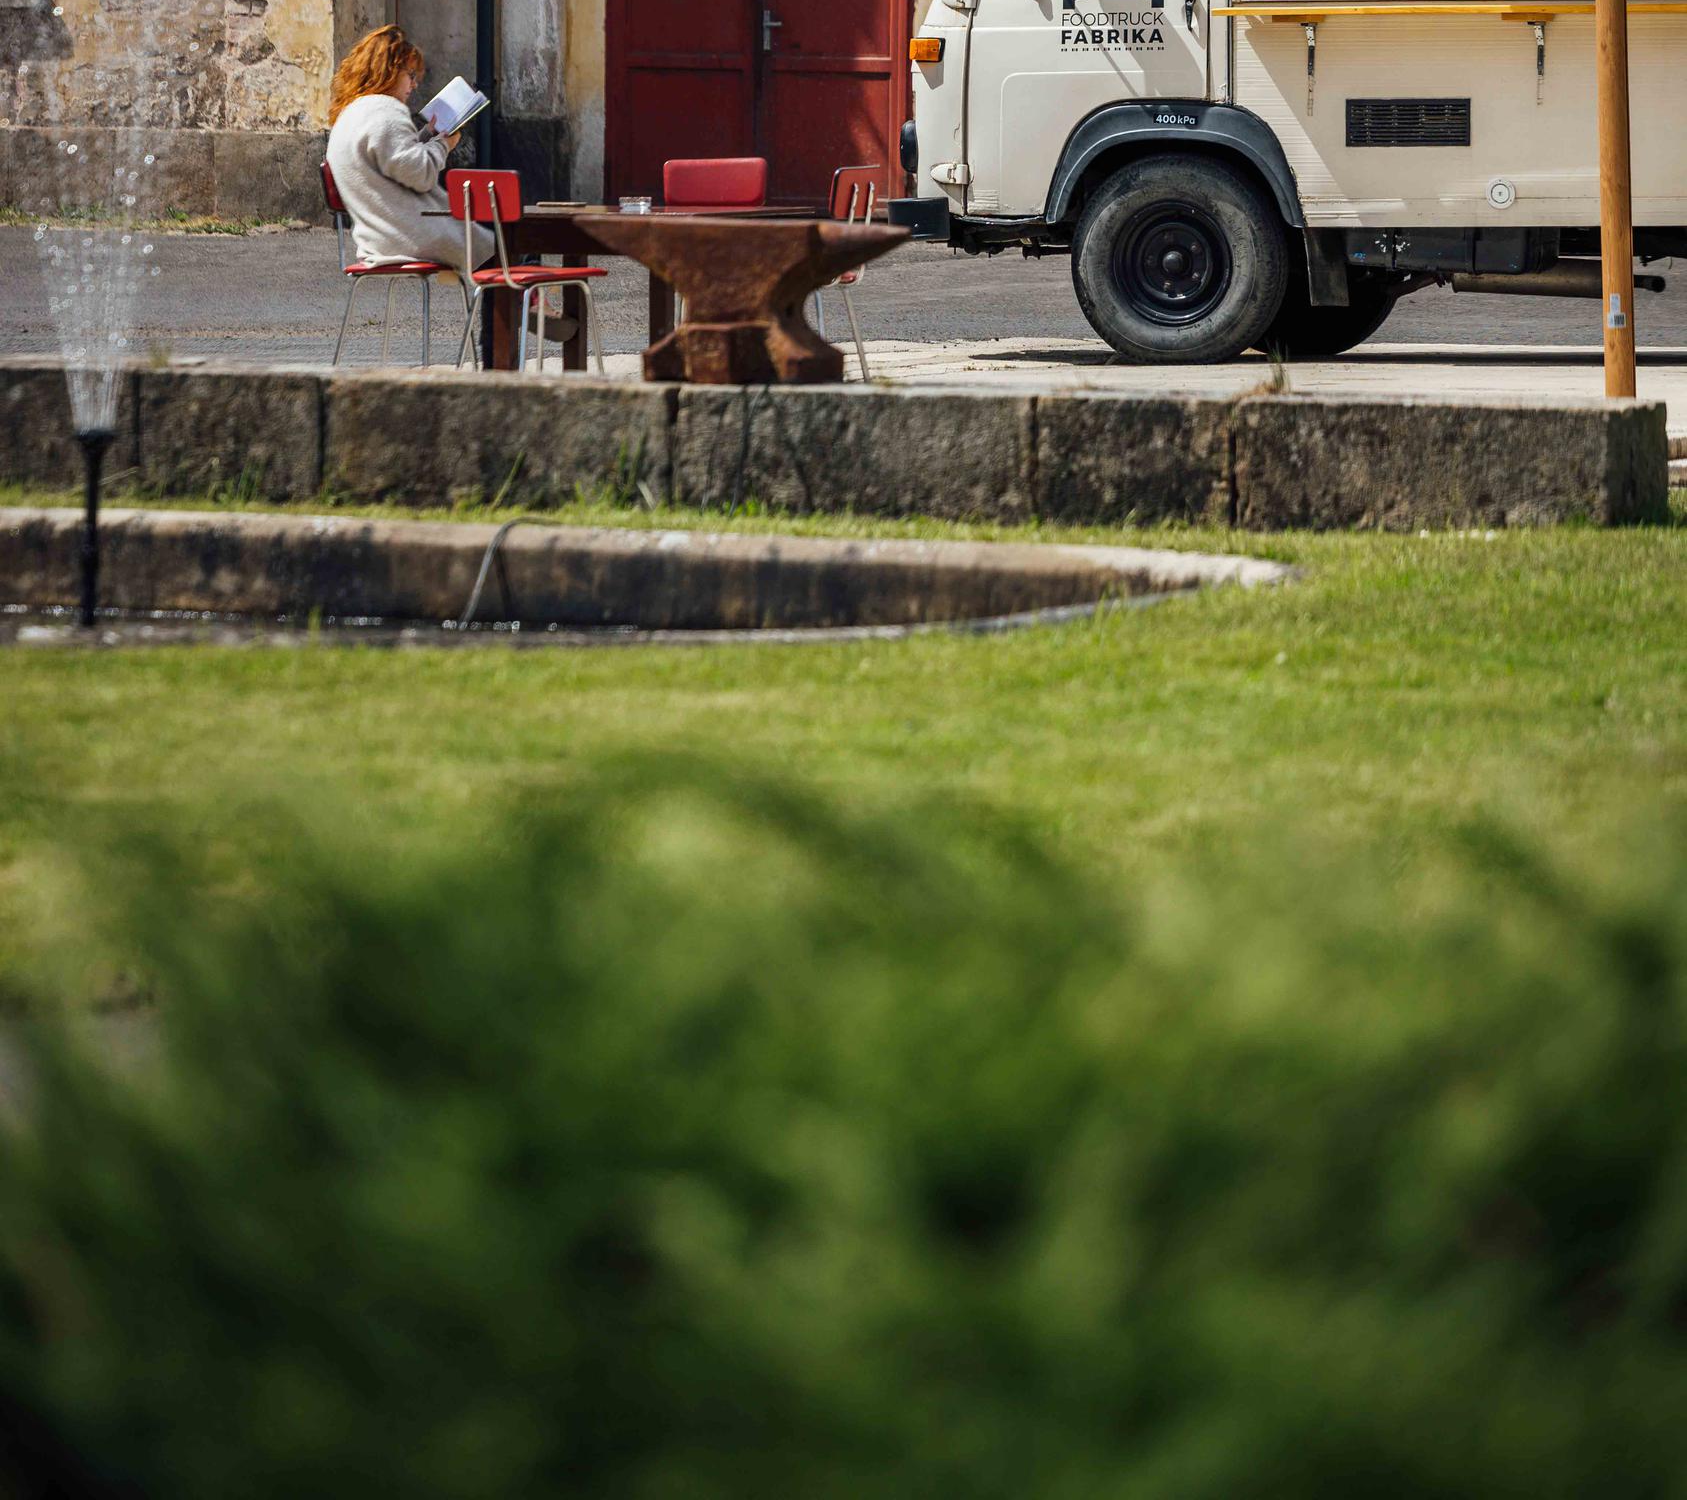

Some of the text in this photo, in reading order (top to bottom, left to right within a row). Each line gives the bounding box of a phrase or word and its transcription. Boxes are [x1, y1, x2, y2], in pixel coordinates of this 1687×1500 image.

[1061, 12, 1165, 27] FOODTRUCK
[1061, 28, 1165, 45] FABRIKA
[1155, 114, 1196, 126] 400 kPa
